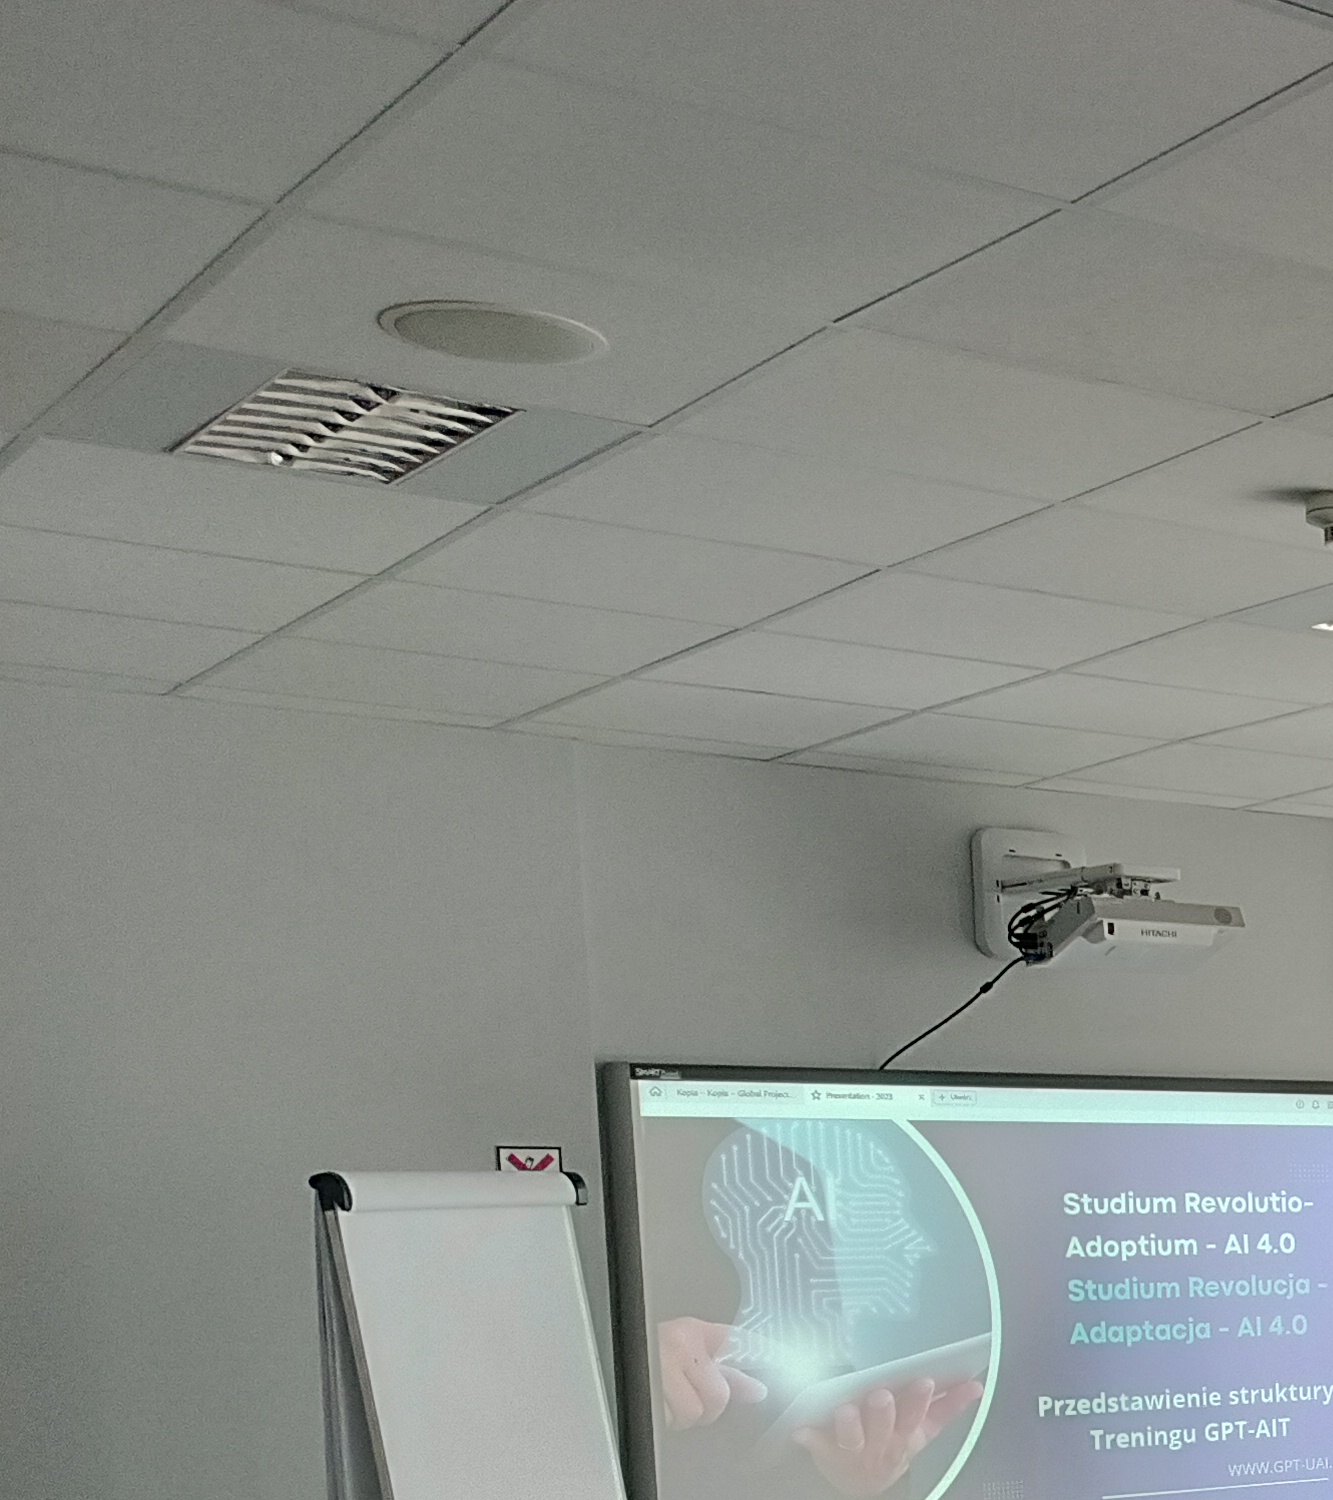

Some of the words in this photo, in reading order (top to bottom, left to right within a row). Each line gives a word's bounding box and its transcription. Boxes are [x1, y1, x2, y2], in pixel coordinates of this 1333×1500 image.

[1141, 929, 1177, 938] HITACHI
[1063, 1190, 1177, 1215] Studium
[1184, 1190, 1314, 1214] Revolutio-
[1065, 1233, 1198, 1261] Adoptium
[1224, 1234, 1249, 1254] AI
[1256, 1233, 1296, 1254] 4.0
[1067, 1276, 1181, 1302] Studium
[1188, 1273, 1311, 1299] Revolucja
[1069, 1316, 1211, 1347] Adaptacja
[1237, 1316, 1262, 1338] AI
[1268, 1314, 1308, 1337] 4.0
[1038, 1386, 1222, 1417] Przedstawienie
[1090, 1424, 1197, 1450] Treningu
[1204, 1418, 1291, 1442] GPT-AIT
